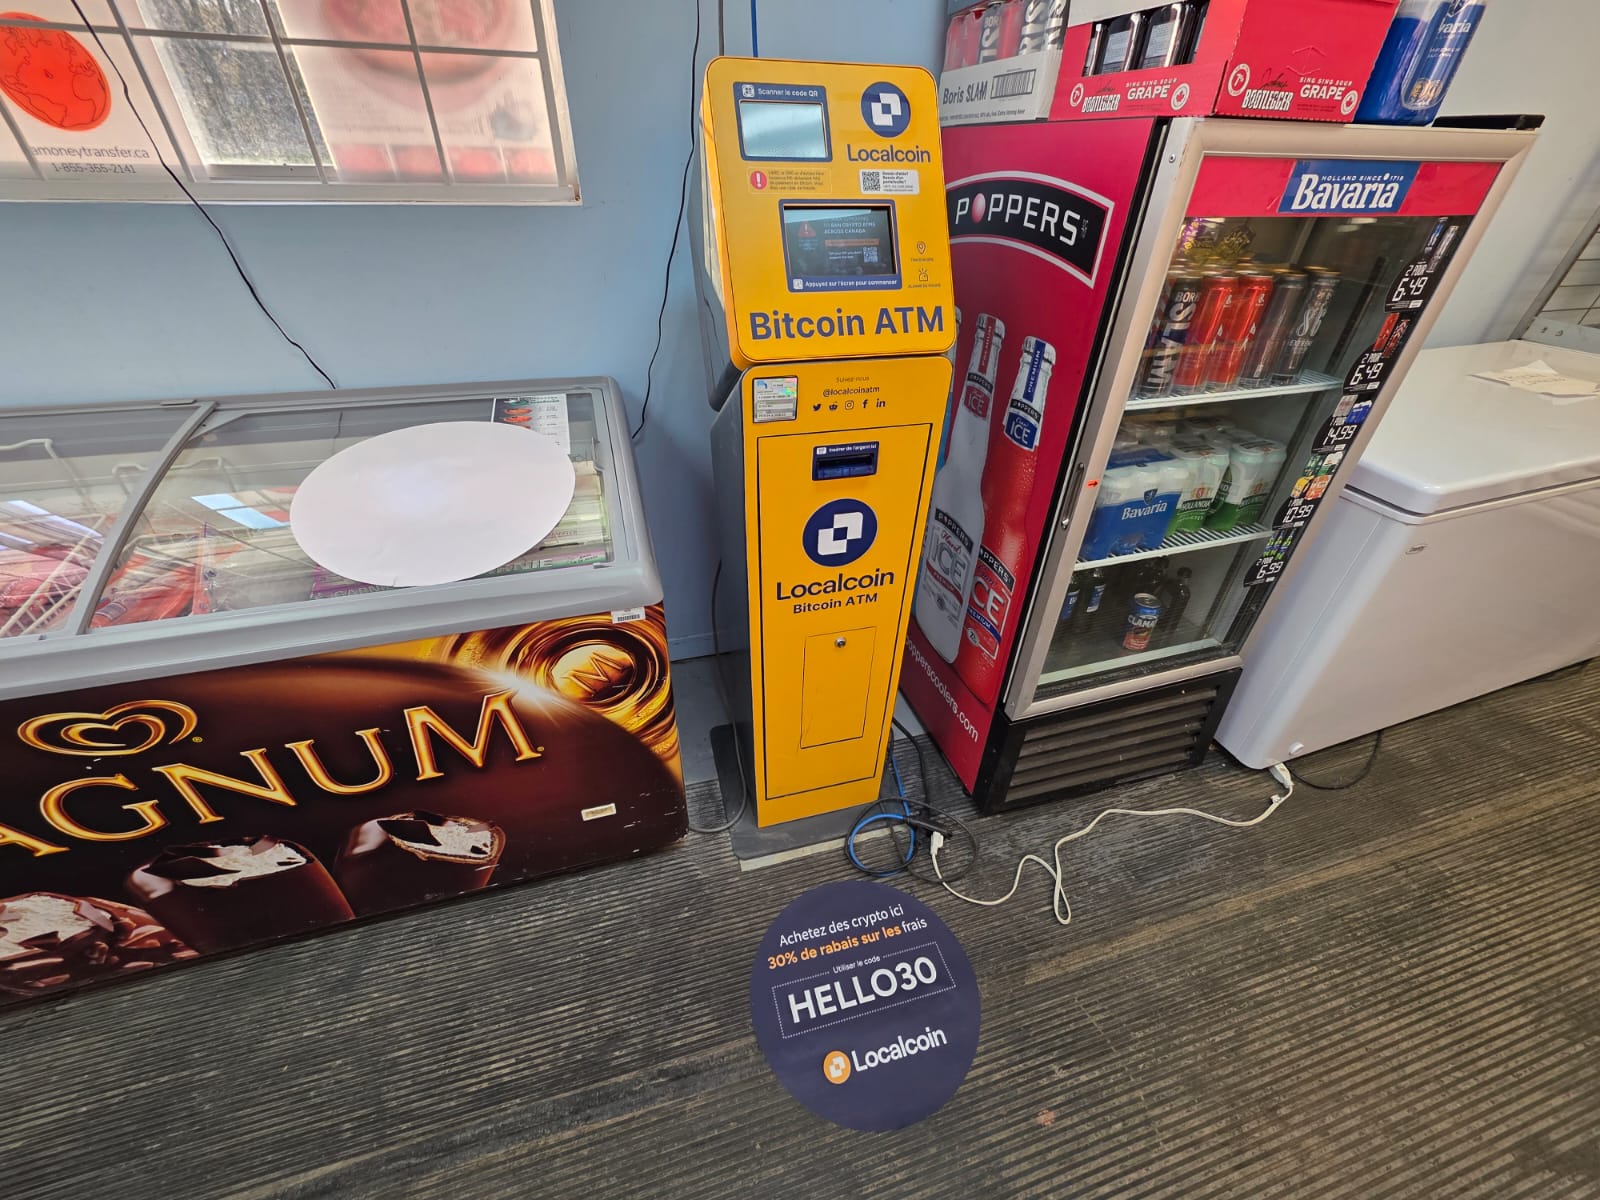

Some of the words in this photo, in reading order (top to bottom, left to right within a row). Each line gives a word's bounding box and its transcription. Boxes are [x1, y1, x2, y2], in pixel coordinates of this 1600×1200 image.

[943, 86, 964, 104] Boris
[966, 80, 988, 103] SLAM
[1081, 94, 1120, 112] BOOTLEGGER
[1127, 84, 1170, 100] GRAPE
[1241, 88, 1294, 111] BOOTLEGGER
[1300, 84, 1345, 100] GRAPE
[847, 143, 931, 163] Localcoin
[1321, 174, 1356, 182] HOLLAND
[1290, 173, 1400, 210] Bavaria
[749, 307, 865, 341] Bitcoin
[875, 305, 944, 335] ATM
[1027, 350, 1041, 393] PREMIUM
[823, 386, 880, 397] @localcoinatm
[967, 392, 985, 415] ICE
[1010, 419, 1031, 445] ICE
[1122, 500, 1168, 521] Bavaria
[931, 533, 967, 592] ICE
[776, 568, 894, 601] Localcoin
[793, 596, 842, 614] Bitcoin
[844, 592, 878, 607] ATM
[779, 925, 827, 947] Achetez
[828, 920, 850, 934] des
[851, 910, 889, 929] crypto
[889, 903, 904, 917] ici
[767, 951, 798, 970] 30%
[800, 947, 818, 961] de
[819, 935, 859, 956] rabais
[861, 932, 881, 944] sur
[882, 925, 902, 939] les
[902, 917, 928, 934] frais
[832, 960, 856, 974] Utiliser
[856, 959, 864, 968] le
[864, 954, 881, 966] code
[787, 956, 938, 1024] HELLO30
[851, 1026, 948, 1073] Localcoin
